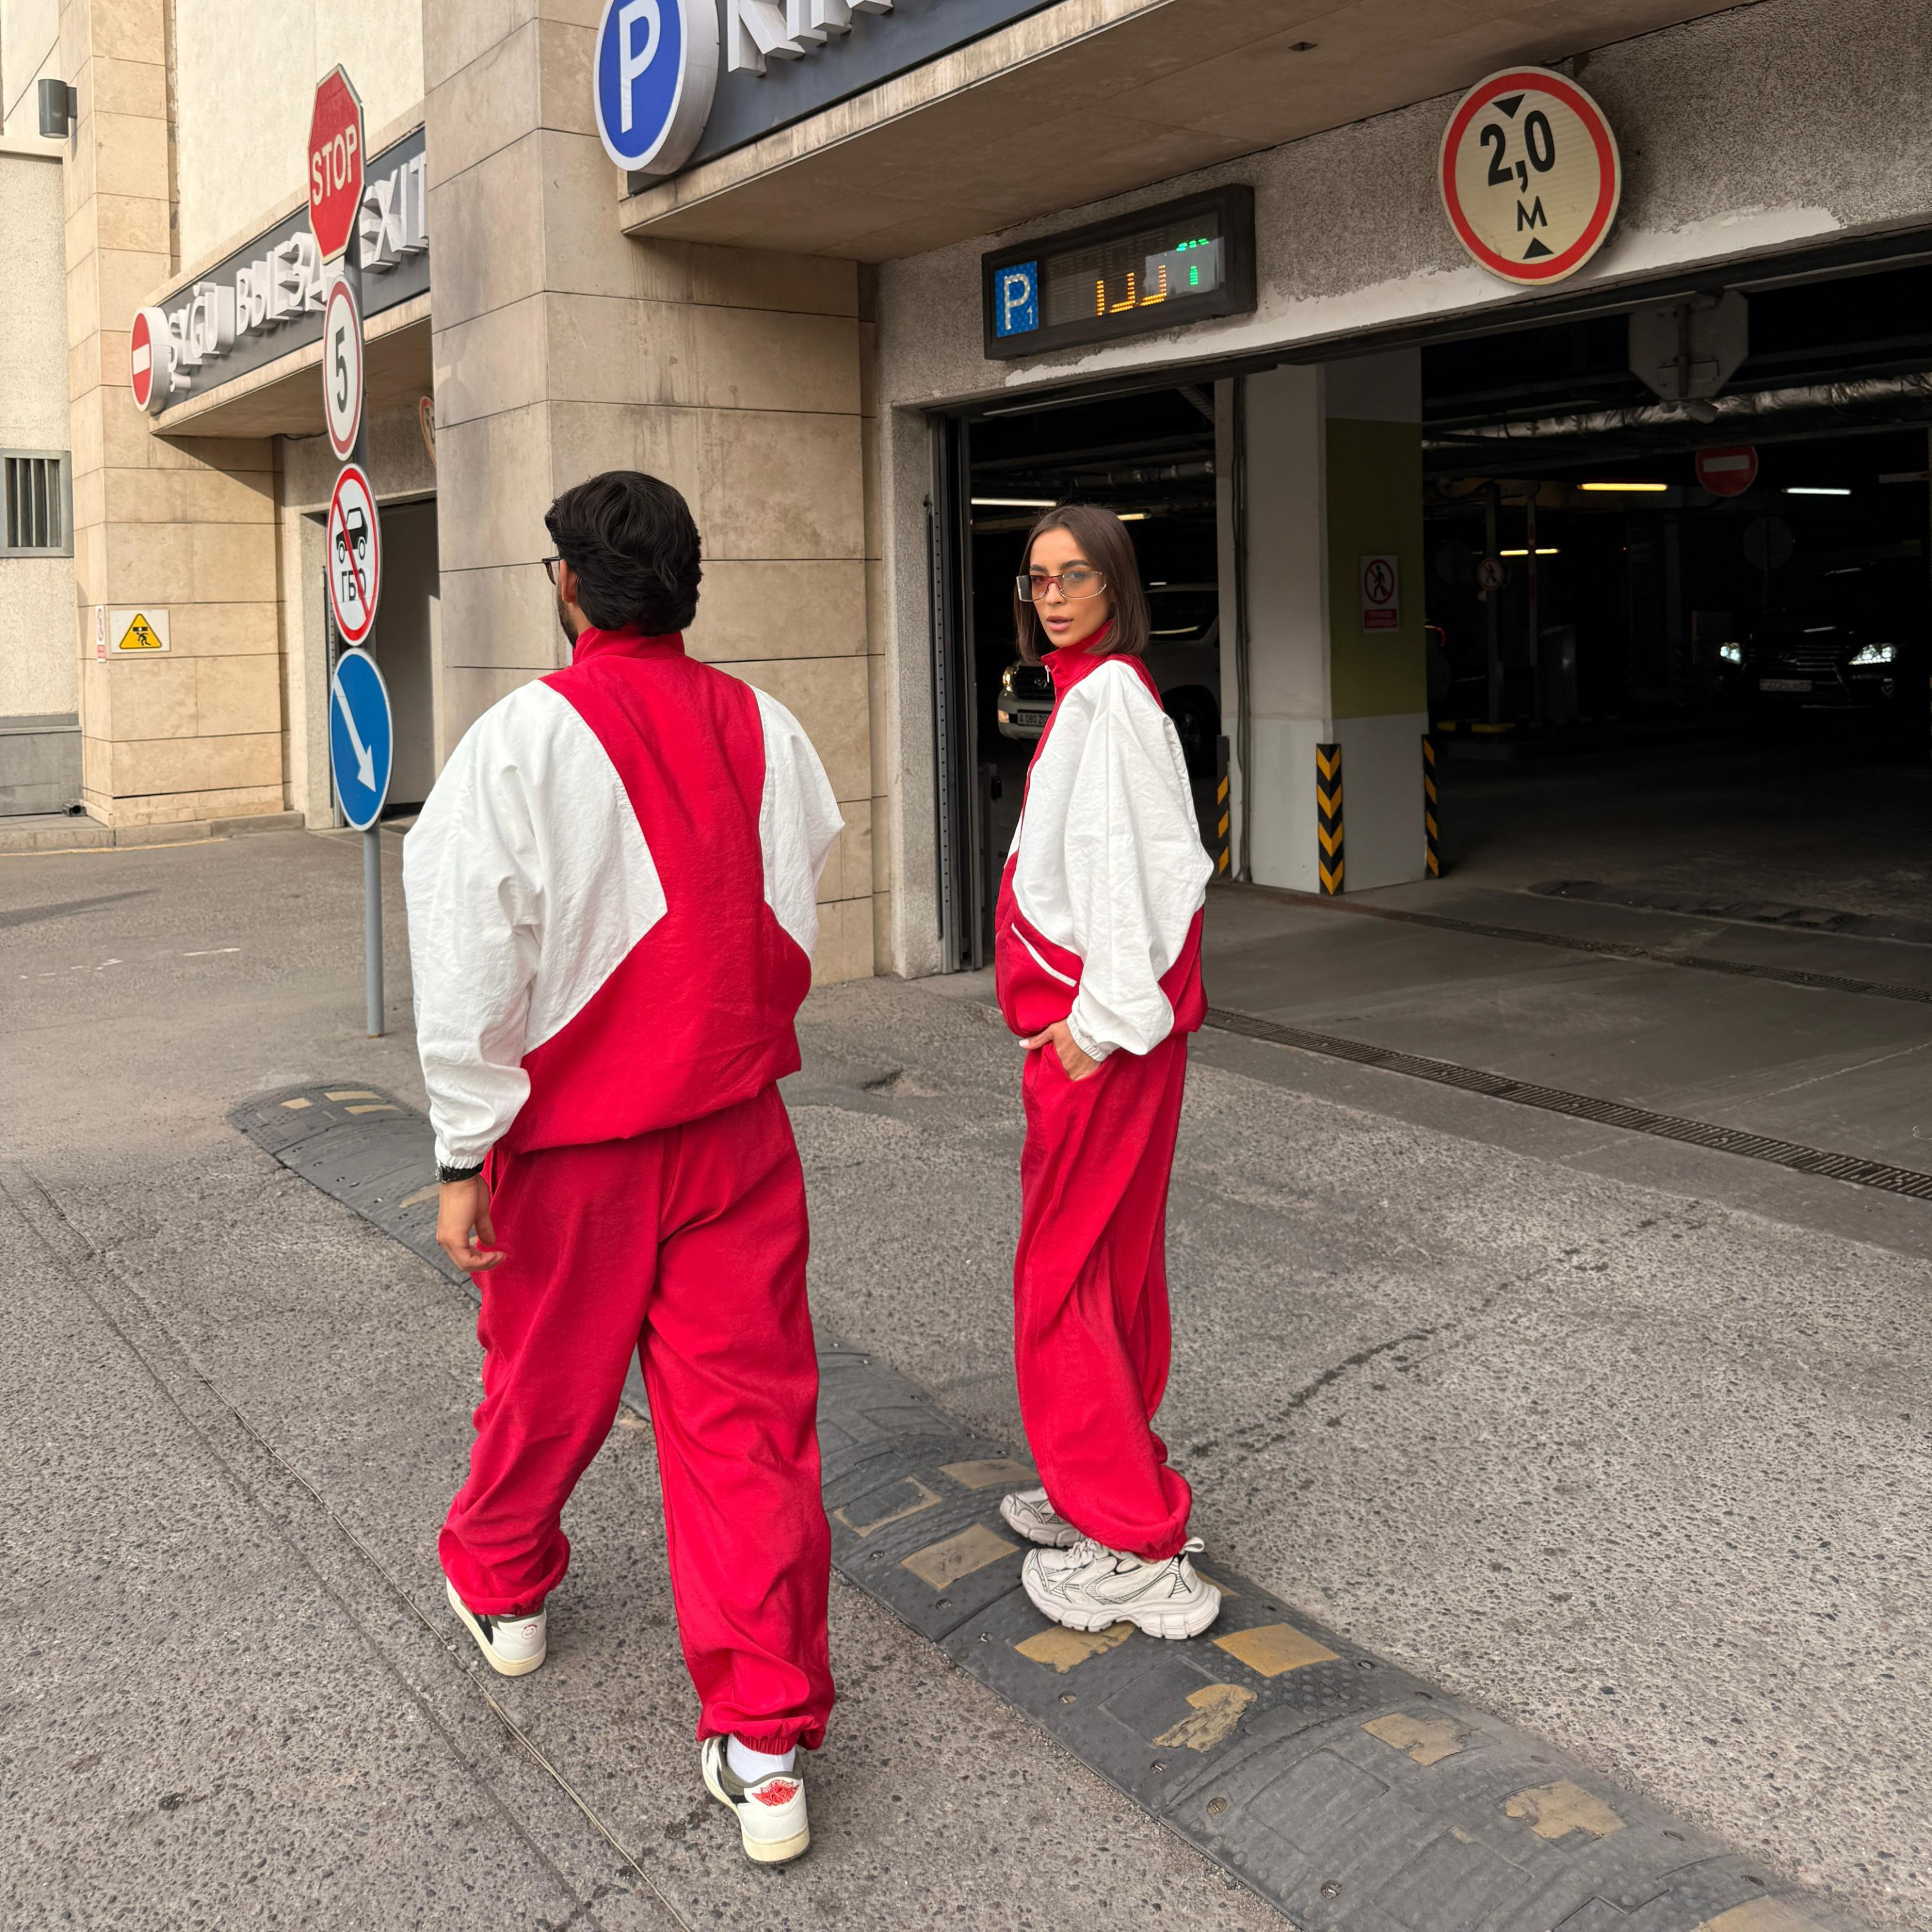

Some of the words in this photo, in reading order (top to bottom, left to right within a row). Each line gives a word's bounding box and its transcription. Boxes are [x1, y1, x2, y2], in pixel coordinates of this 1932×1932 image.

[619, 0, 661, 133] P
[312, 124, 357, 206] STOP
[1480, 110, 1555, 194] 2,0
[359, 151, 427, 270] EXIT
[335, 325, 346, 413] 5
